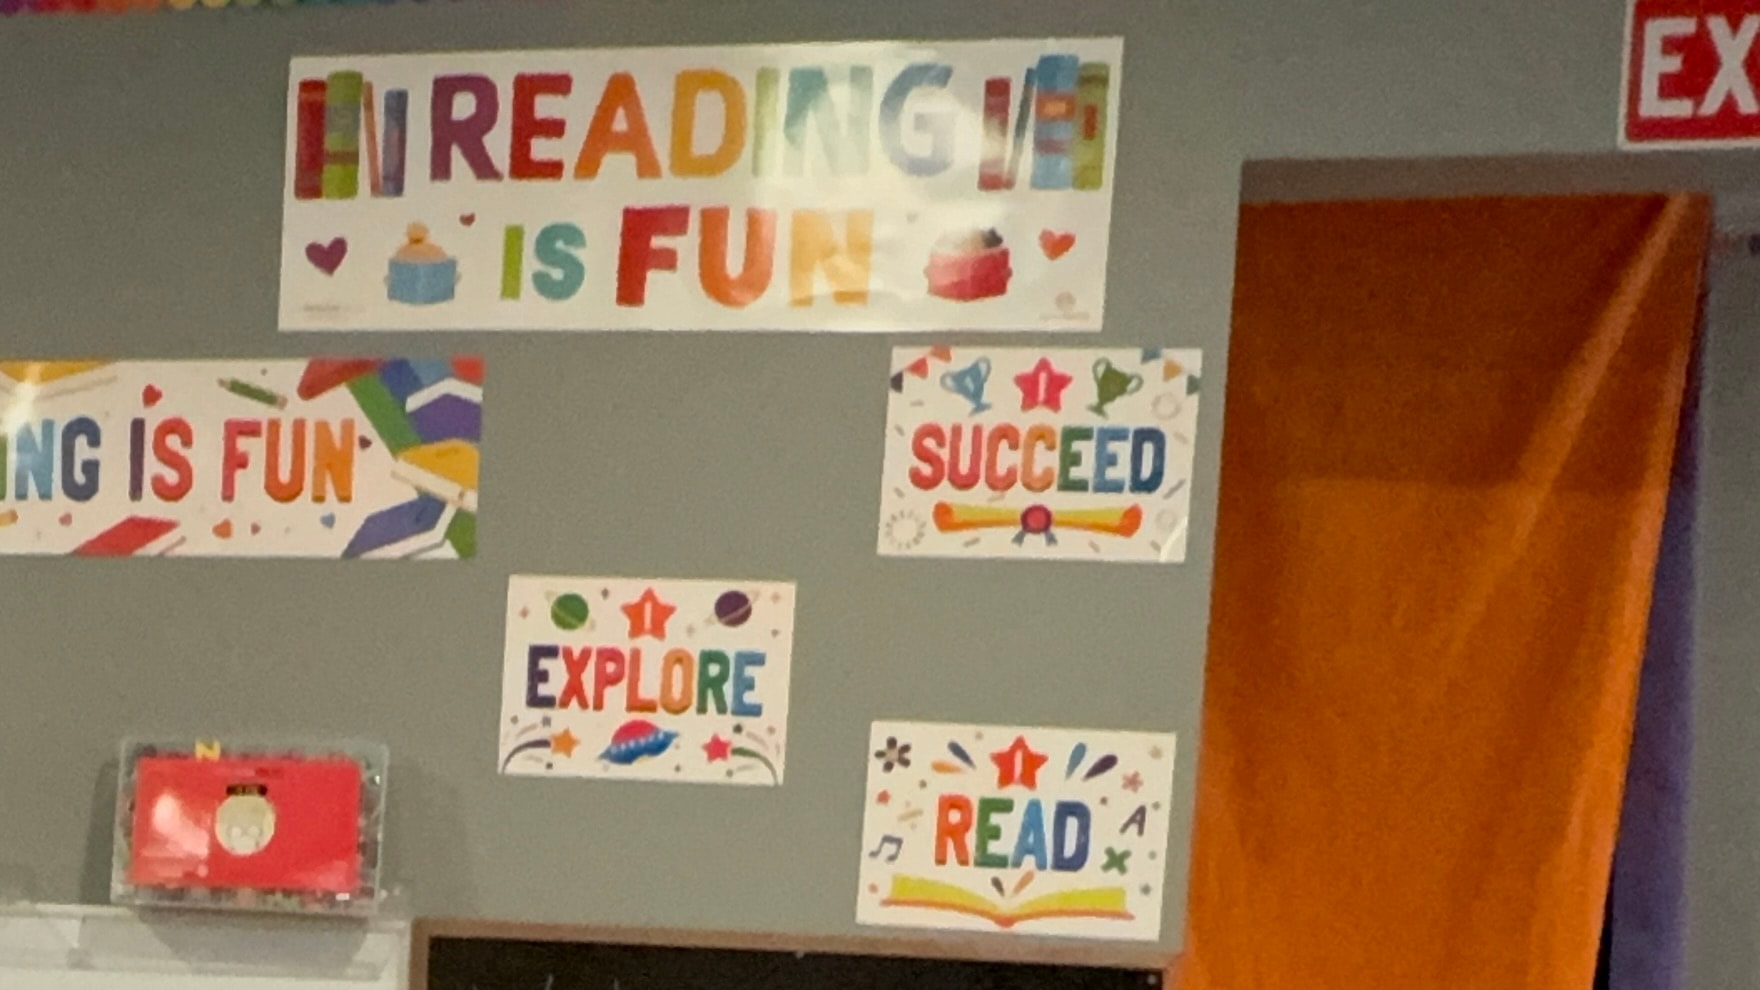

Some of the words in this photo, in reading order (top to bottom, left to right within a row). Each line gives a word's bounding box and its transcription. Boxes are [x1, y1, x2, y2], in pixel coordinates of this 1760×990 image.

[1638, 13, 1760, 118] EX
[429, 61, 956, 182] READING
[500, 221, 587, 302] IS
[615, 204, 875, 309] FUN
[129, 416, 194, 503] IS
[221, 416, 357, 504] FUN
[908, 422, 1167, 495] SUCCEED
[524, 644, 767, 718] EXPLORE
[933, 794, 1092, 873] READ
